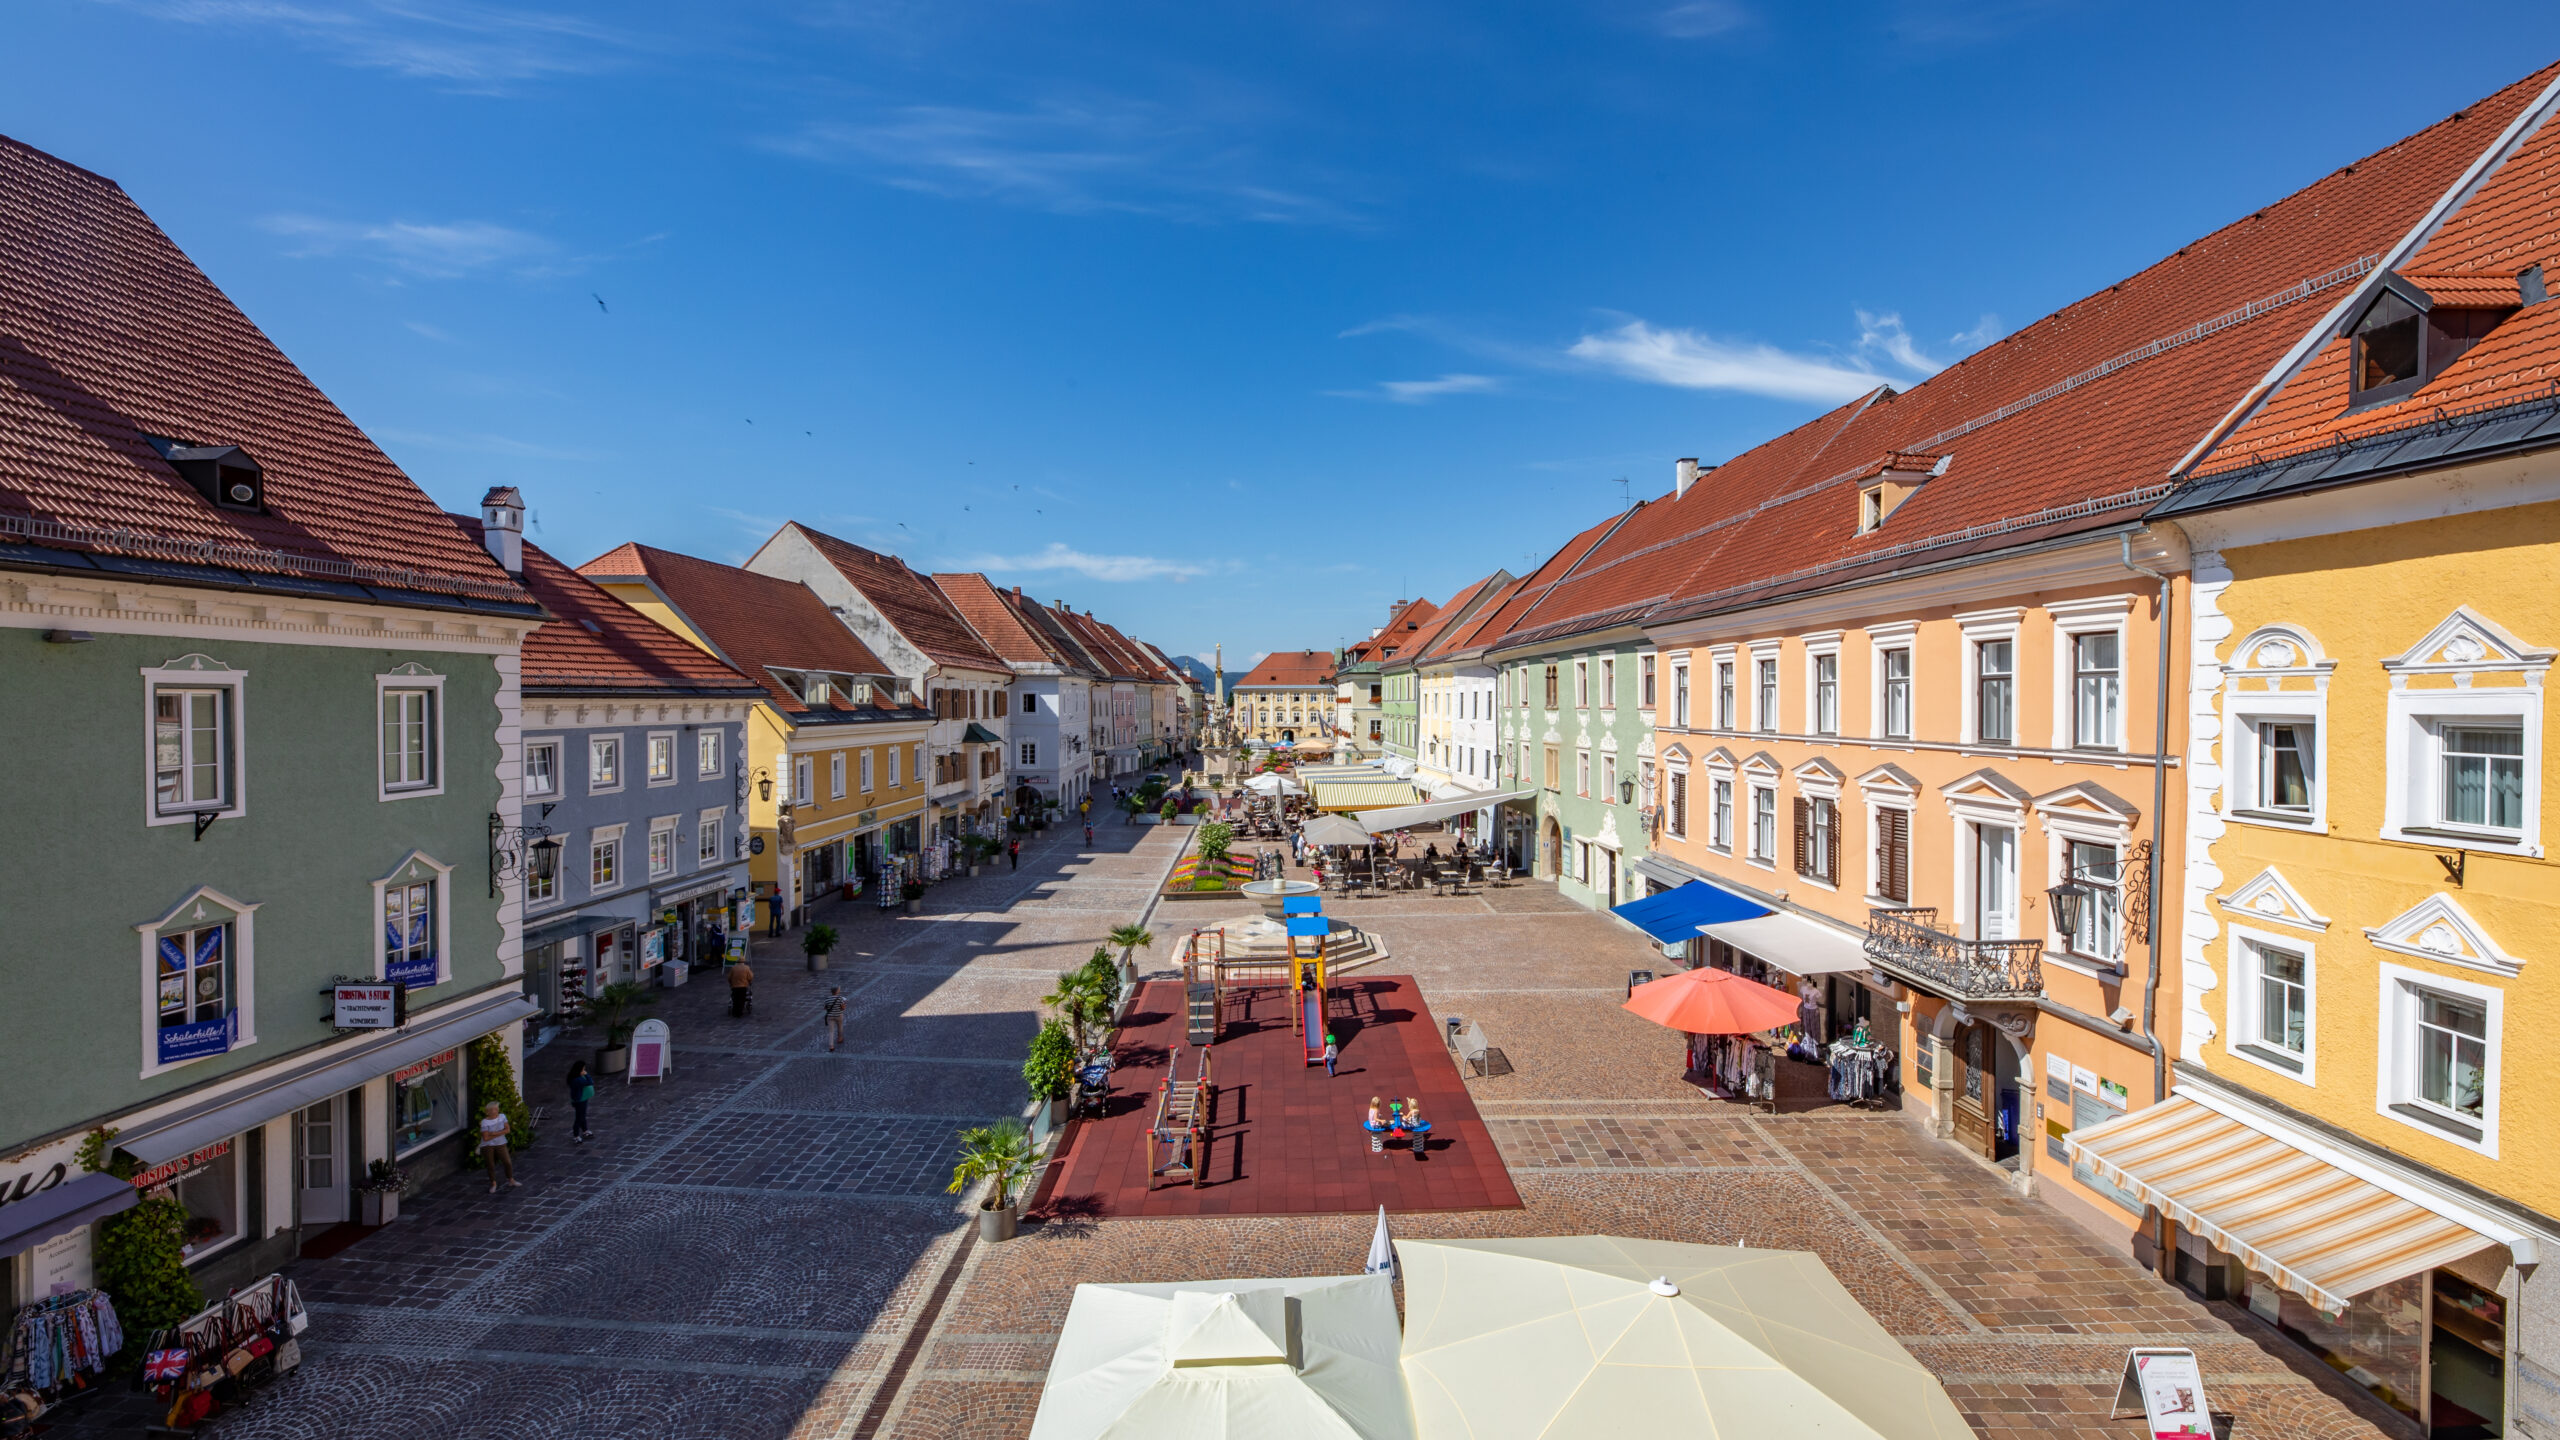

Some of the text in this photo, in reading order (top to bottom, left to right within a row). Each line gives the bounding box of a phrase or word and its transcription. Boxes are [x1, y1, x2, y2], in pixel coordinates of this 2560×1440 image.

[678, 888, 698, 899] TABAK
[373, 989, 391, 1001] STUBE
[431, 1050, 455, 1068] STUBE
[193, 1140, 230, 1165] STUBE
